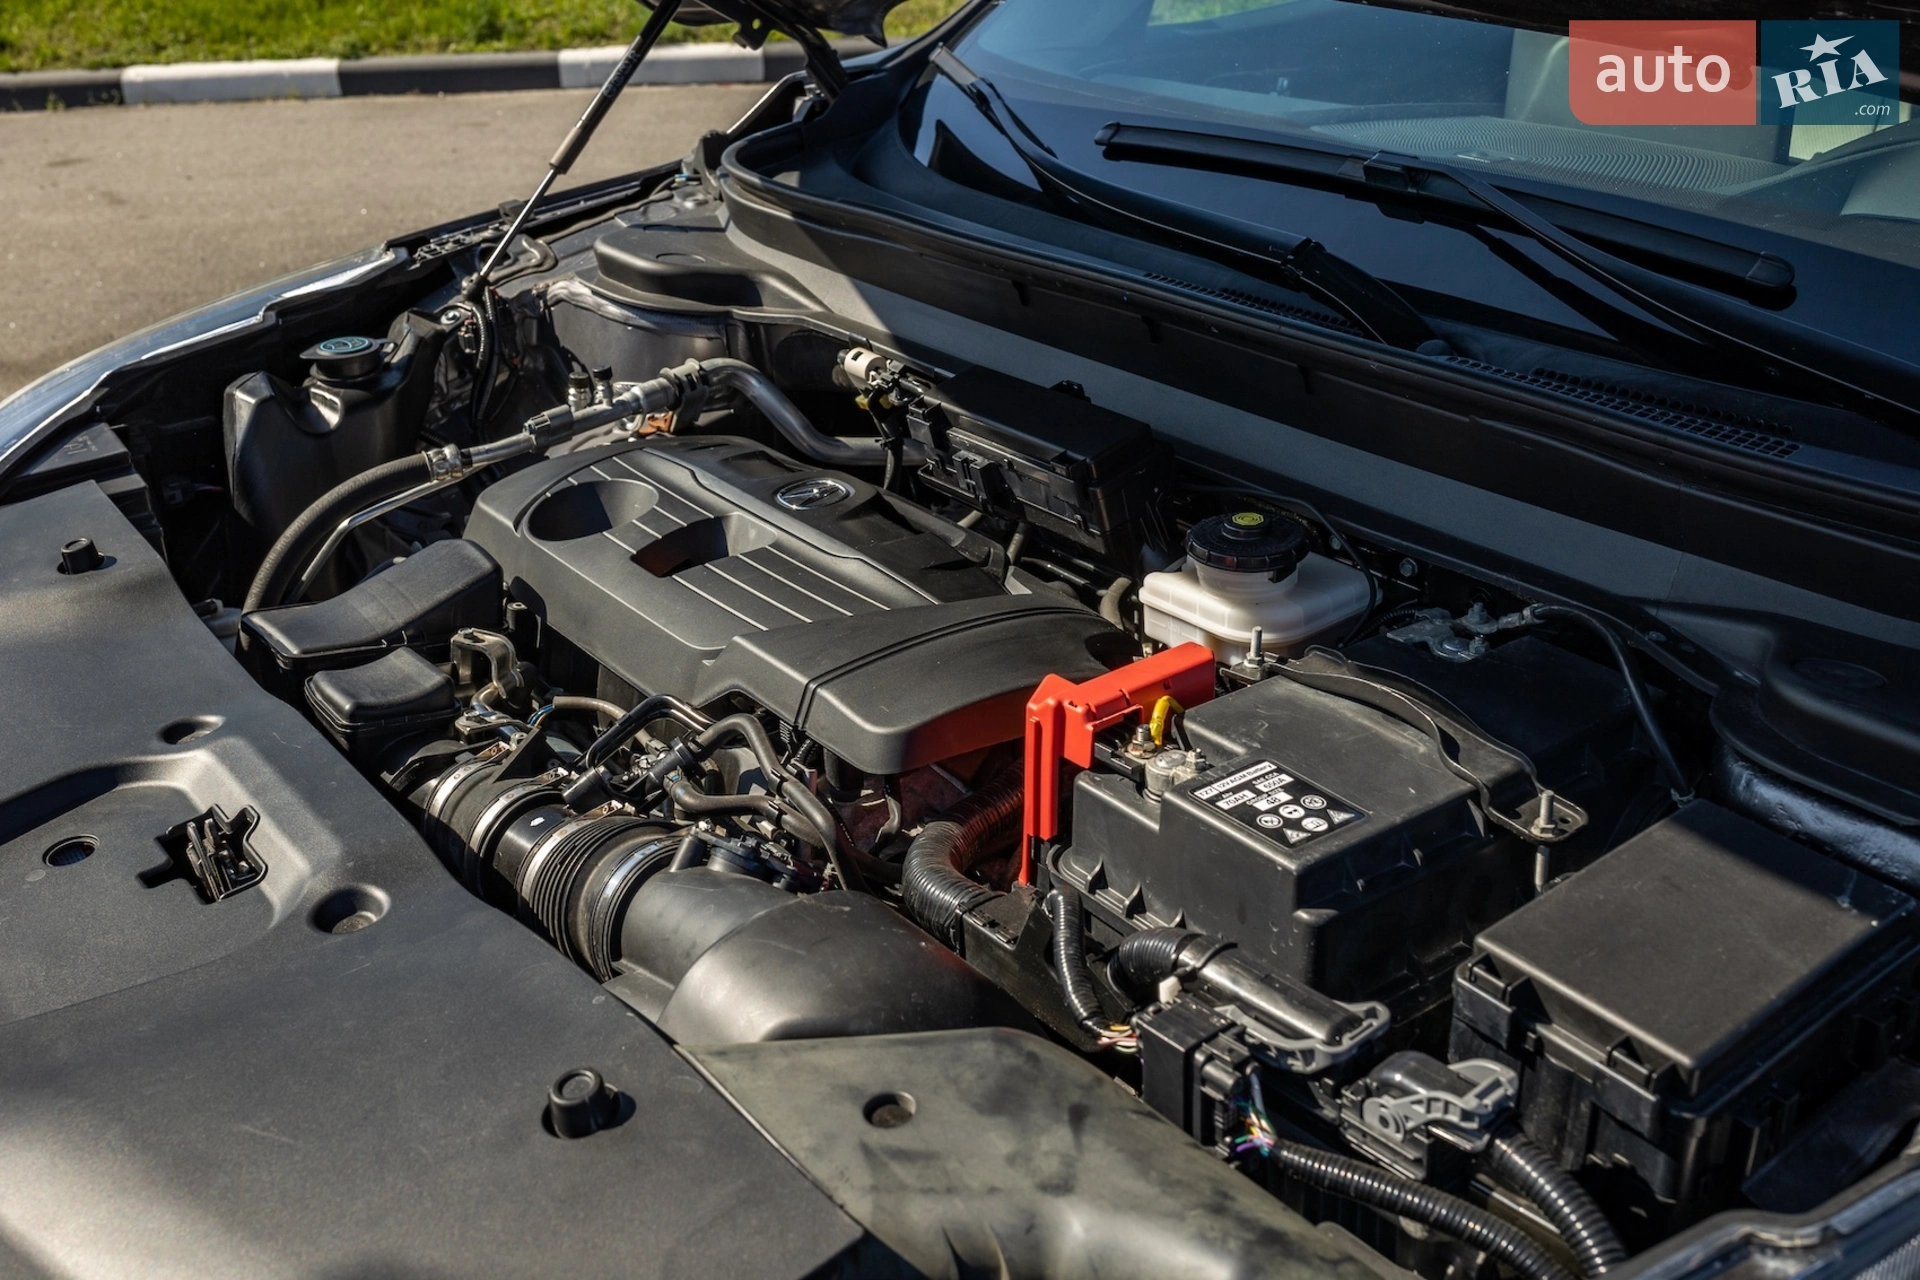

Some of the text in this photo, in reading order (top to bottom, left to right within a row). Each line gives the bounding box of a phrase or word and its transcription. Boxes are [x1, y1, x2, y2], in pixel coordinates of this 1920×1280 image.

[1217, 780, 1231, 789] 12V
[1230, 773, 1248, 783] AGM
[1246, 764, 1273, 776] Battery
[1222, 793, 1248, 806] 70AH
[1266, 796, 1282, 805] 48
